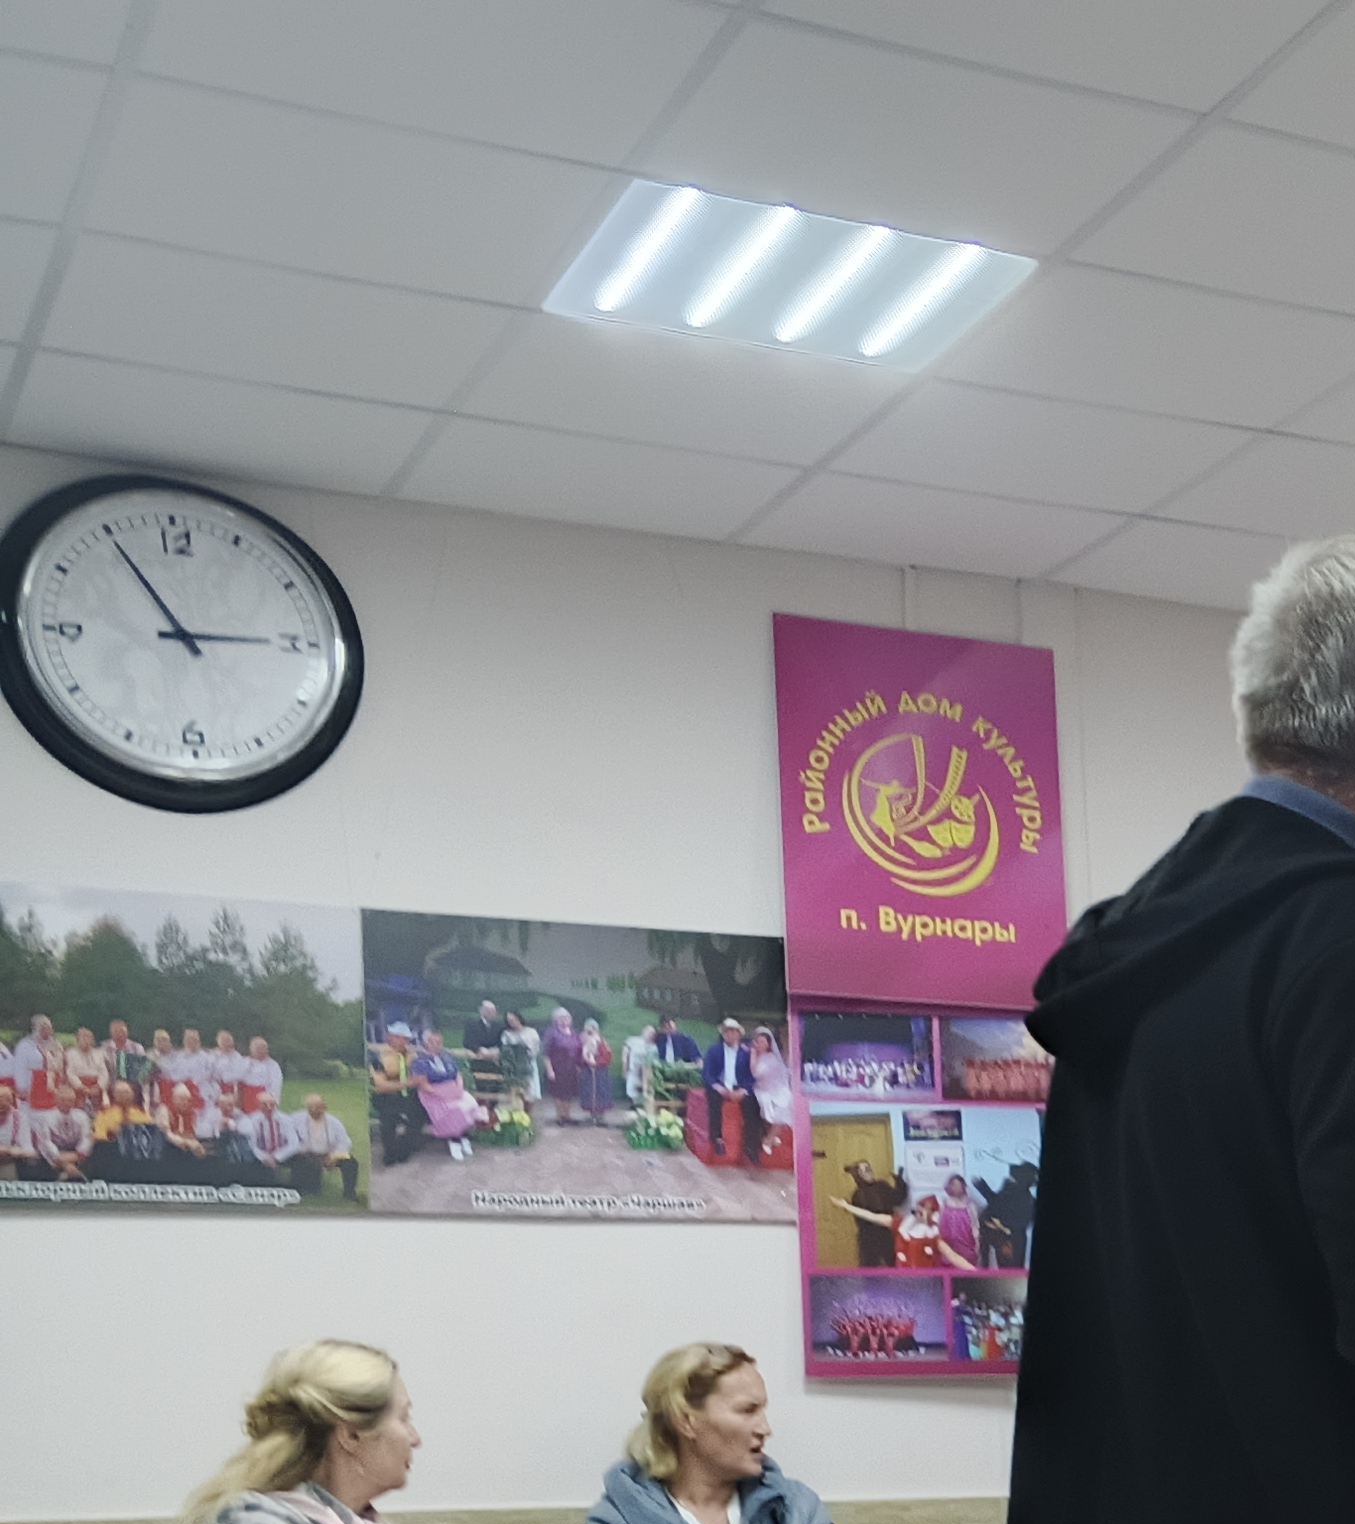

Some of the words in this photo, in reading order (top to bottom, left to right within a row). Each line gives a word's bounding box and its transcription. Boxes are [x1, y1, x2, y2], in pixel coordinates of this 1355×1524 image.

[161, 528, 195, 558] 12
[58, 621, 83, 644] 9
[182, 719, 206, 748] 6
[799, 689, 888, 834] Районный
[972, 716, 1043, 854] культуры
[839, 907, 867, 931] п.
[878, 905, 1017, 946] Вурнары
[473, 1191, 566, 1211] Народный
[569, 1196, 618, 1213] театр
